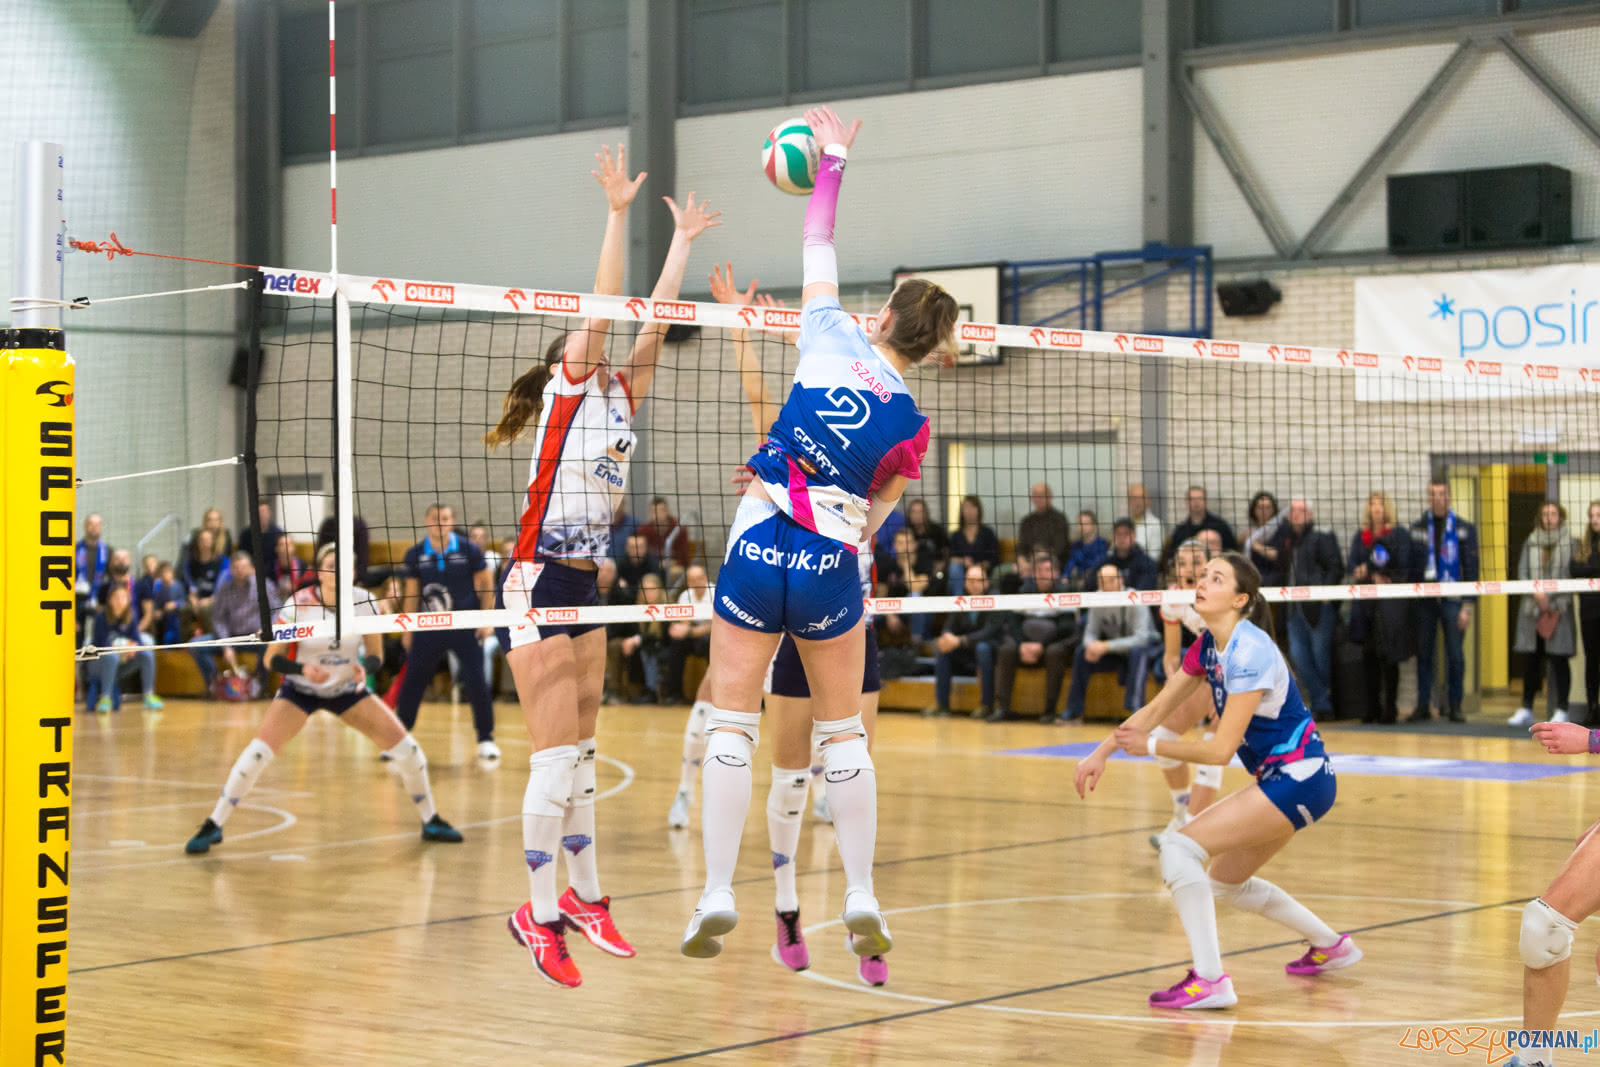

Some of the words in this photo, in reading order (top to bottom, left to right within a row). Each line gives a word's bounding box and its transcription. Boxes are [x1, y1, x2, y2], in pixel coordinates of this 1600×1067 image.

[263, 272, 321, 294] netex
[406, 284, 453, 302] ORLEN
[536, 294, 578, 311] ORLEN
[654, 303, 694, 319] ORLEN
[962, 325, 995, 340] ORLEN
[851, 361, 892, 403] SZABO
[815, 385, 871, 450] 2
[594, 463, 624, 487] Enea
[39, 421, 73, 636] SPORT
[272, 625, 315, 641] netex
[418, 614, 451, 627] ORLEN
[547, 610, 577, 621] ORLEN
[665, 606, 693, 617] ORLEN
[34, 717, 71, 1067] TRANSFER
